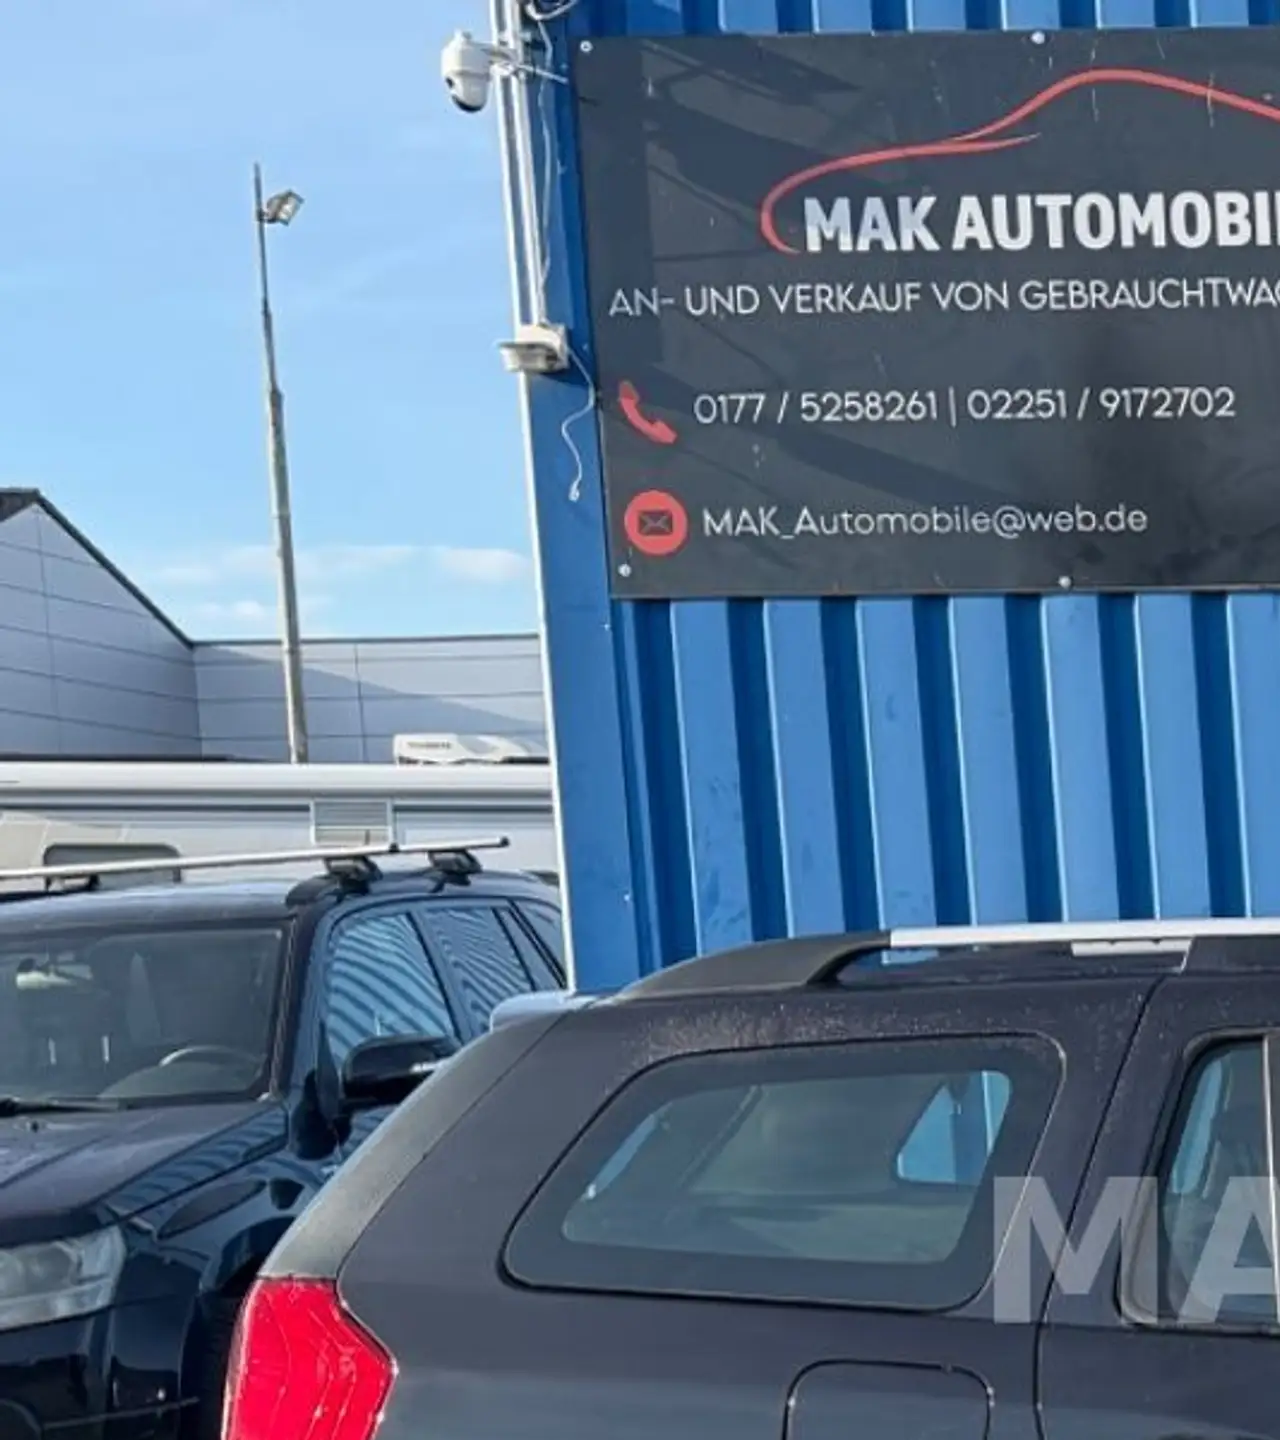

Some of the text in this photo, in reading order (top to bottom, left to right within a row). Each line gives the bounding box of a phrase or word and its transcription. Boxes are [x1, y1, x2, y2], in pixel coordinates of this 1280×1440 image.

[803, 195, 942, 254] MAK
[608, 287, 676, 317] AN-
[684, 284, 761, 316] UND
[767, 281, 923, 314] VERKAUF
[930, 280, 1010, 312] VON
[693, 392, 768, 424] 0177
[799, 389, 939, 422] 5258261
[966, 388, 1068, 421] 02251
[1098, 385, 1237, 419] 9172702
[702, 504, 1148, 541] MAK_Automobile@web.de
